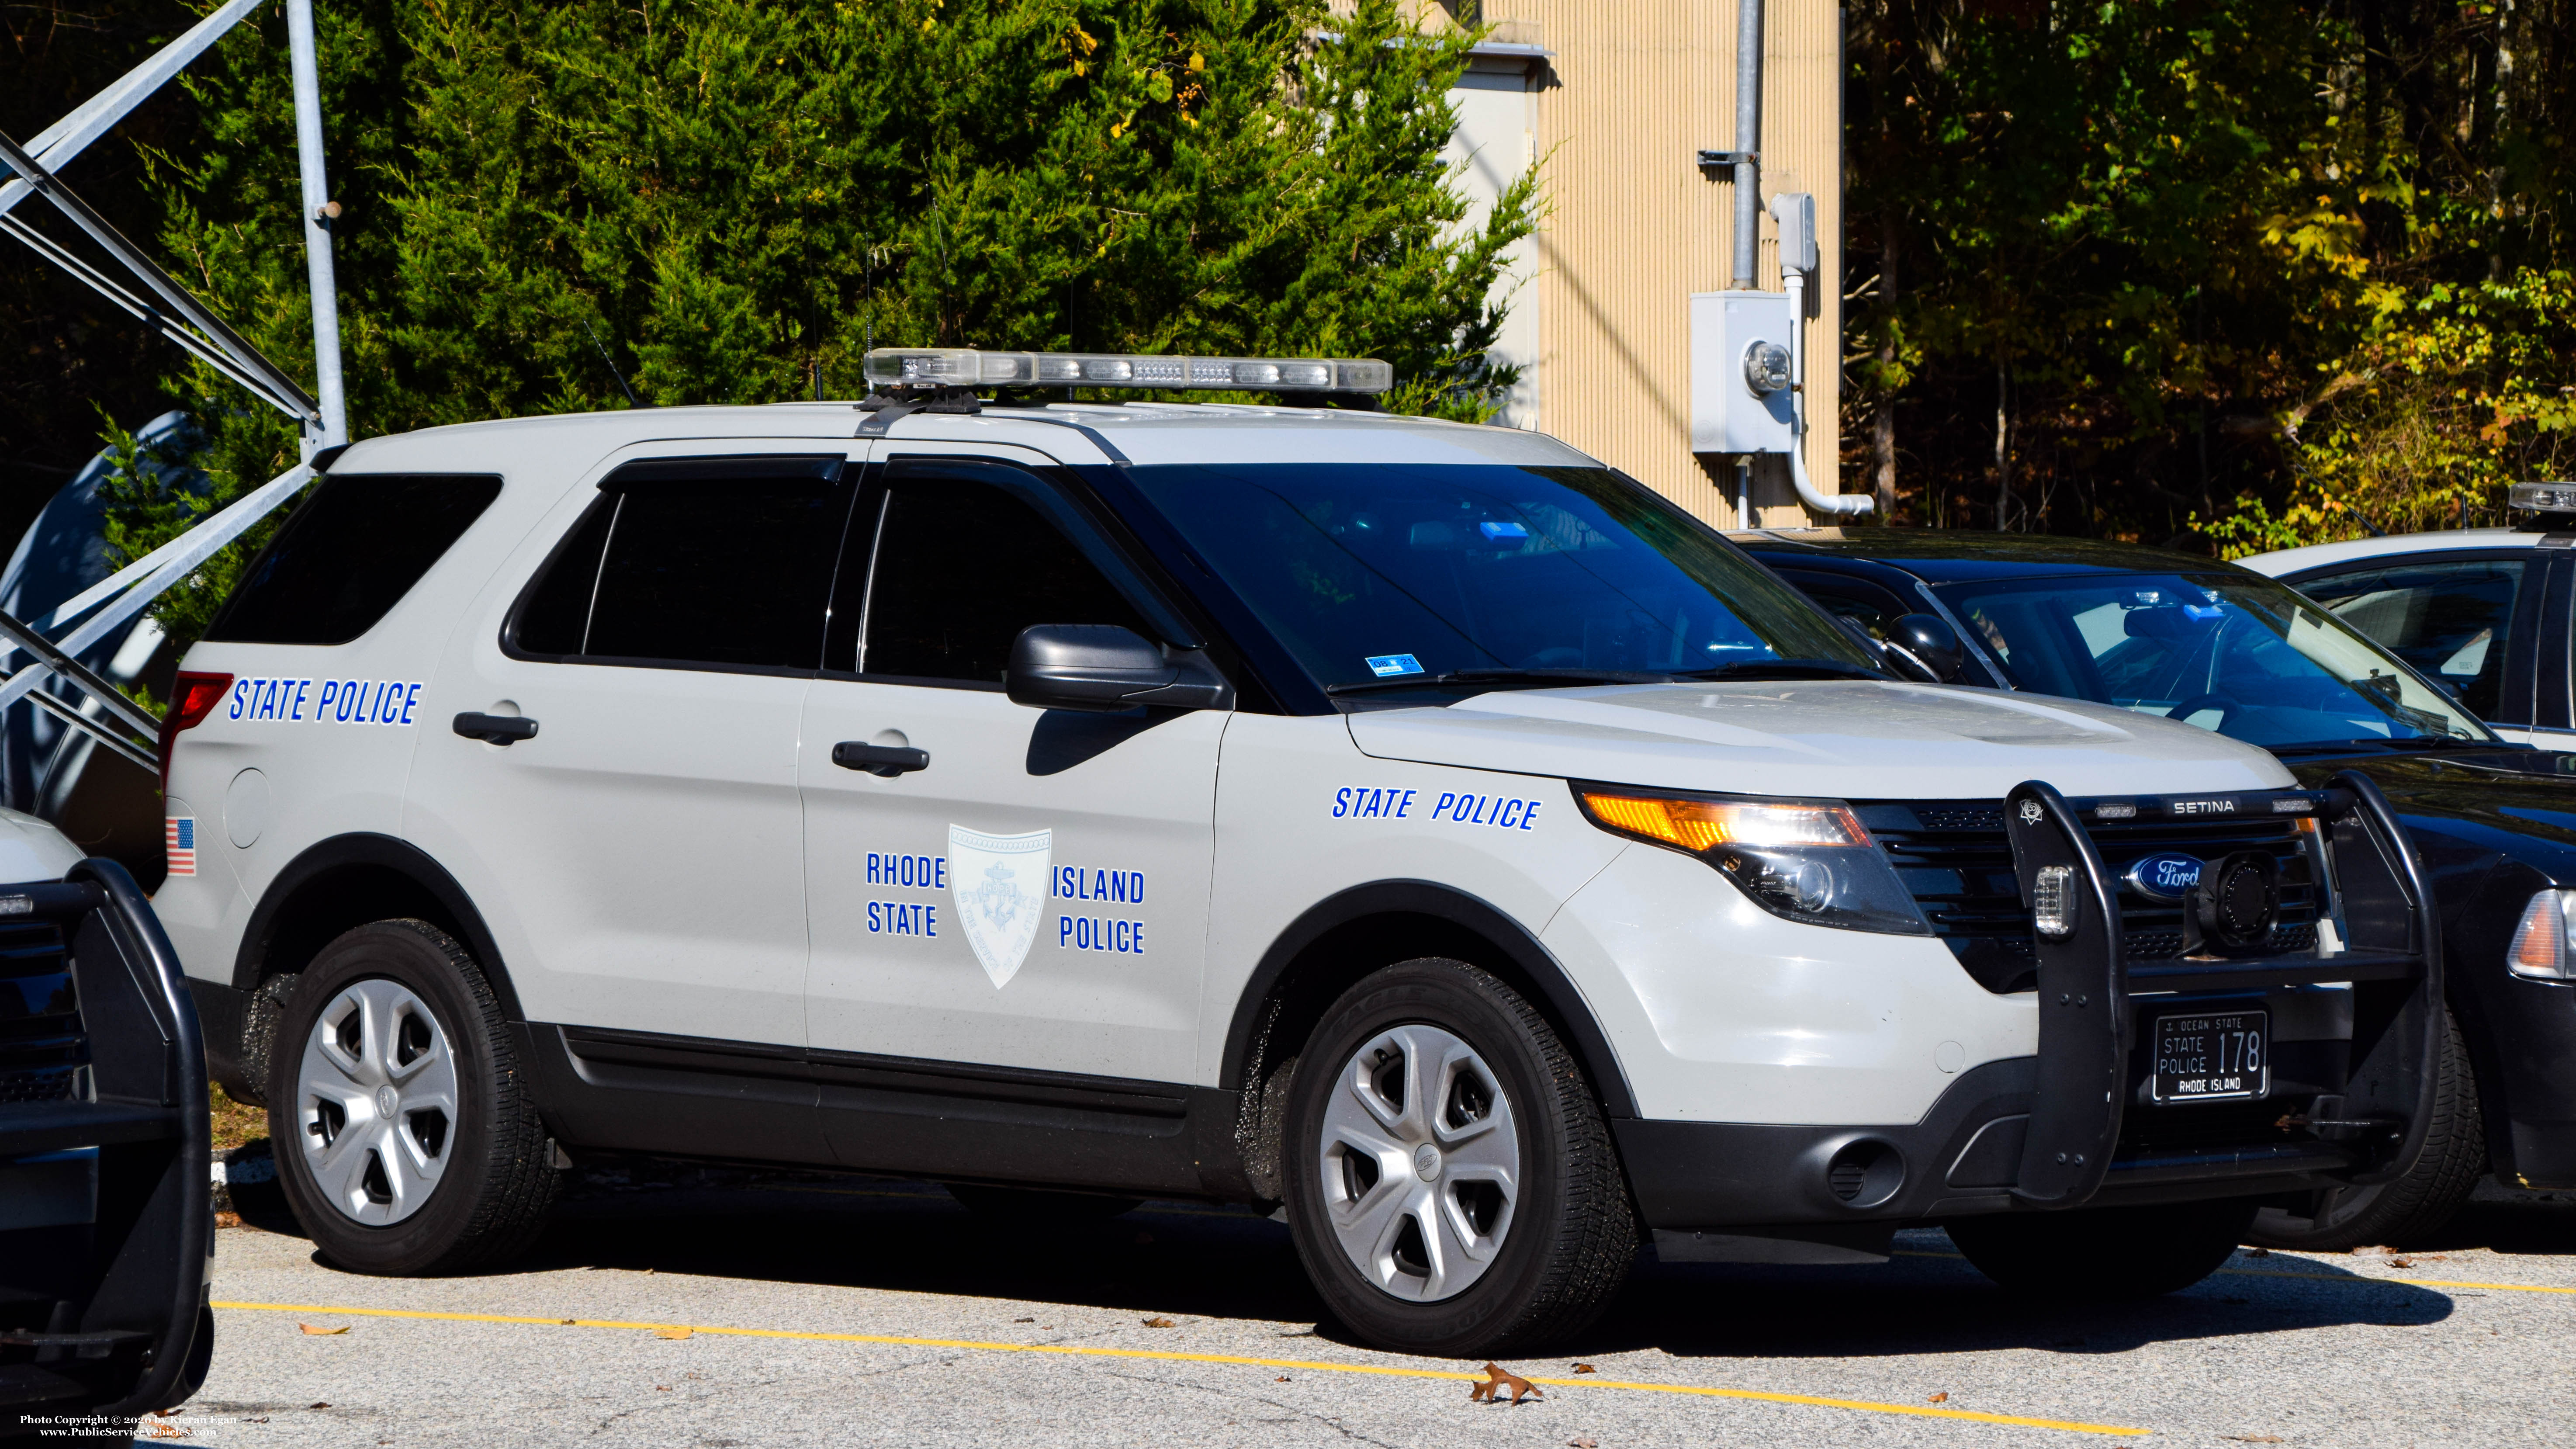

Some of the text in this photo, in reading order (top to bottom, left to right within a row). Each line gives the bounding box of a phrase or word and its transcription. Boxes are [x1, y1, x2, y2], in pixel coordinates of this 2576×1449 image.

[228, 676, 423, 727] STATE POLICE
[1331, 785, 1543, 832] STATE POLICE
[2174, 801, 2235, 813] SETINA
[866, 851, 1145, 905] RHODE ISLAND
[2157, 860, 2200, 887] Ford
[987, 883, 1011, 895] HOPE
[866, 900, 1145, 955] STATE POLICE
[2181, 1018, 2242, 1031] OCEAN STATE
[2165, 1036, 2204, 1054] STATE
[2220, 1031, 2260, 1074] 178
[2160, 1057, 2206, 1075] POLICE
[2180, 1077, 2240, 1092] RHODE ISLAND
